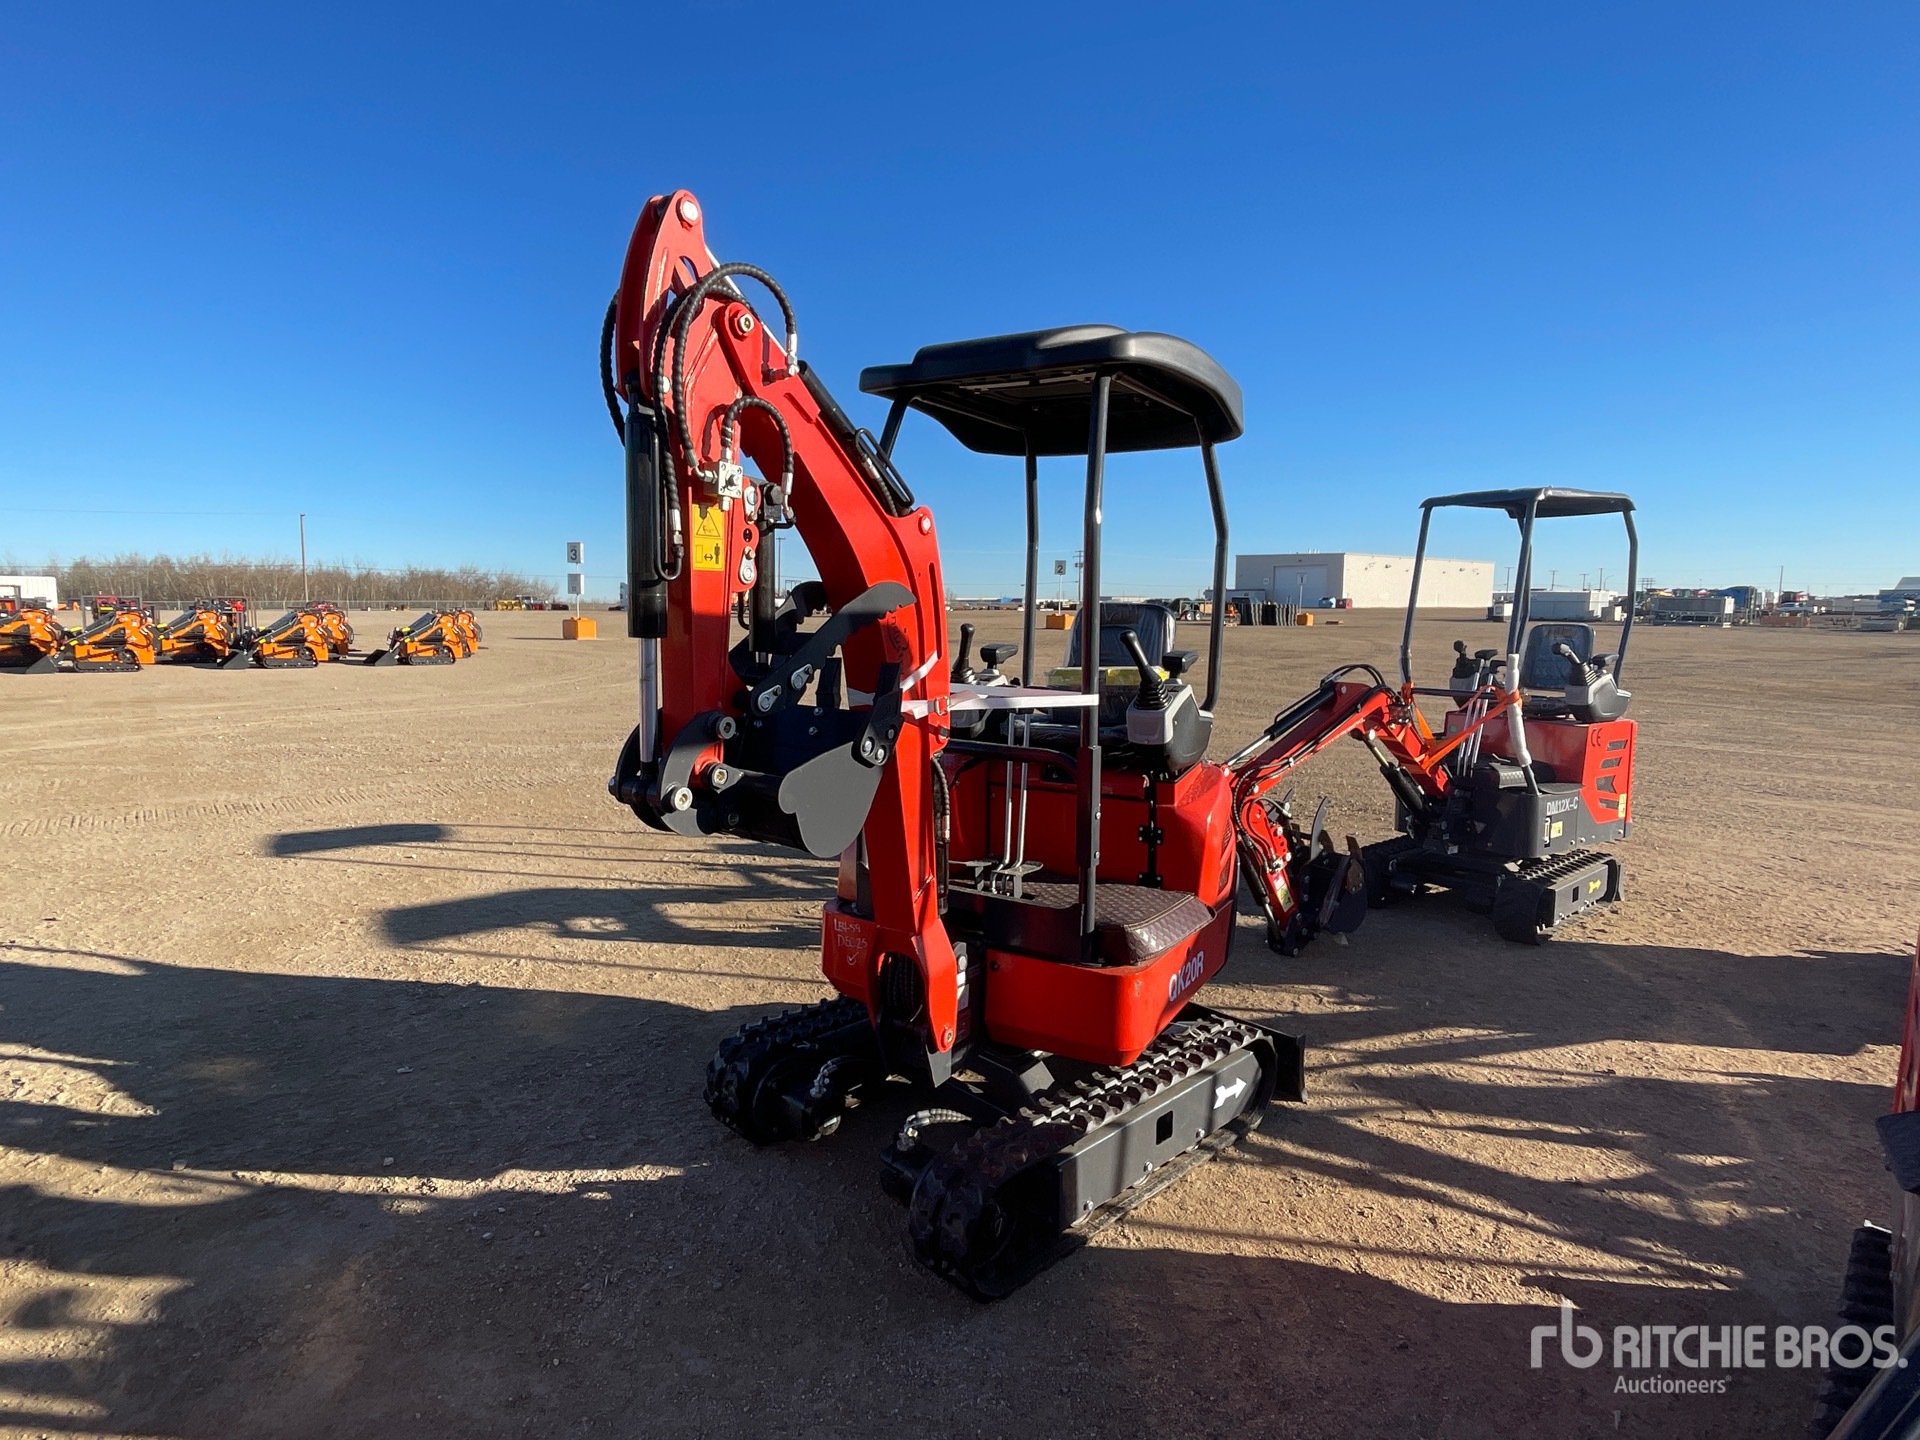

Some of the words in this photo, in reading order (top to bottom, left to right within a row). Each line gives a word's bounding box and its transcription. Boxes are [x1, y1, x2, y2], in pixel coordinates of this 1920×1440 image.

[570, 548, 577, 560] 3
[1057, 565, 1063, 573] 2
[1546, 796, 1578, 815] DM12X-C
[1169, 951, 1204, 1001] QK20R
